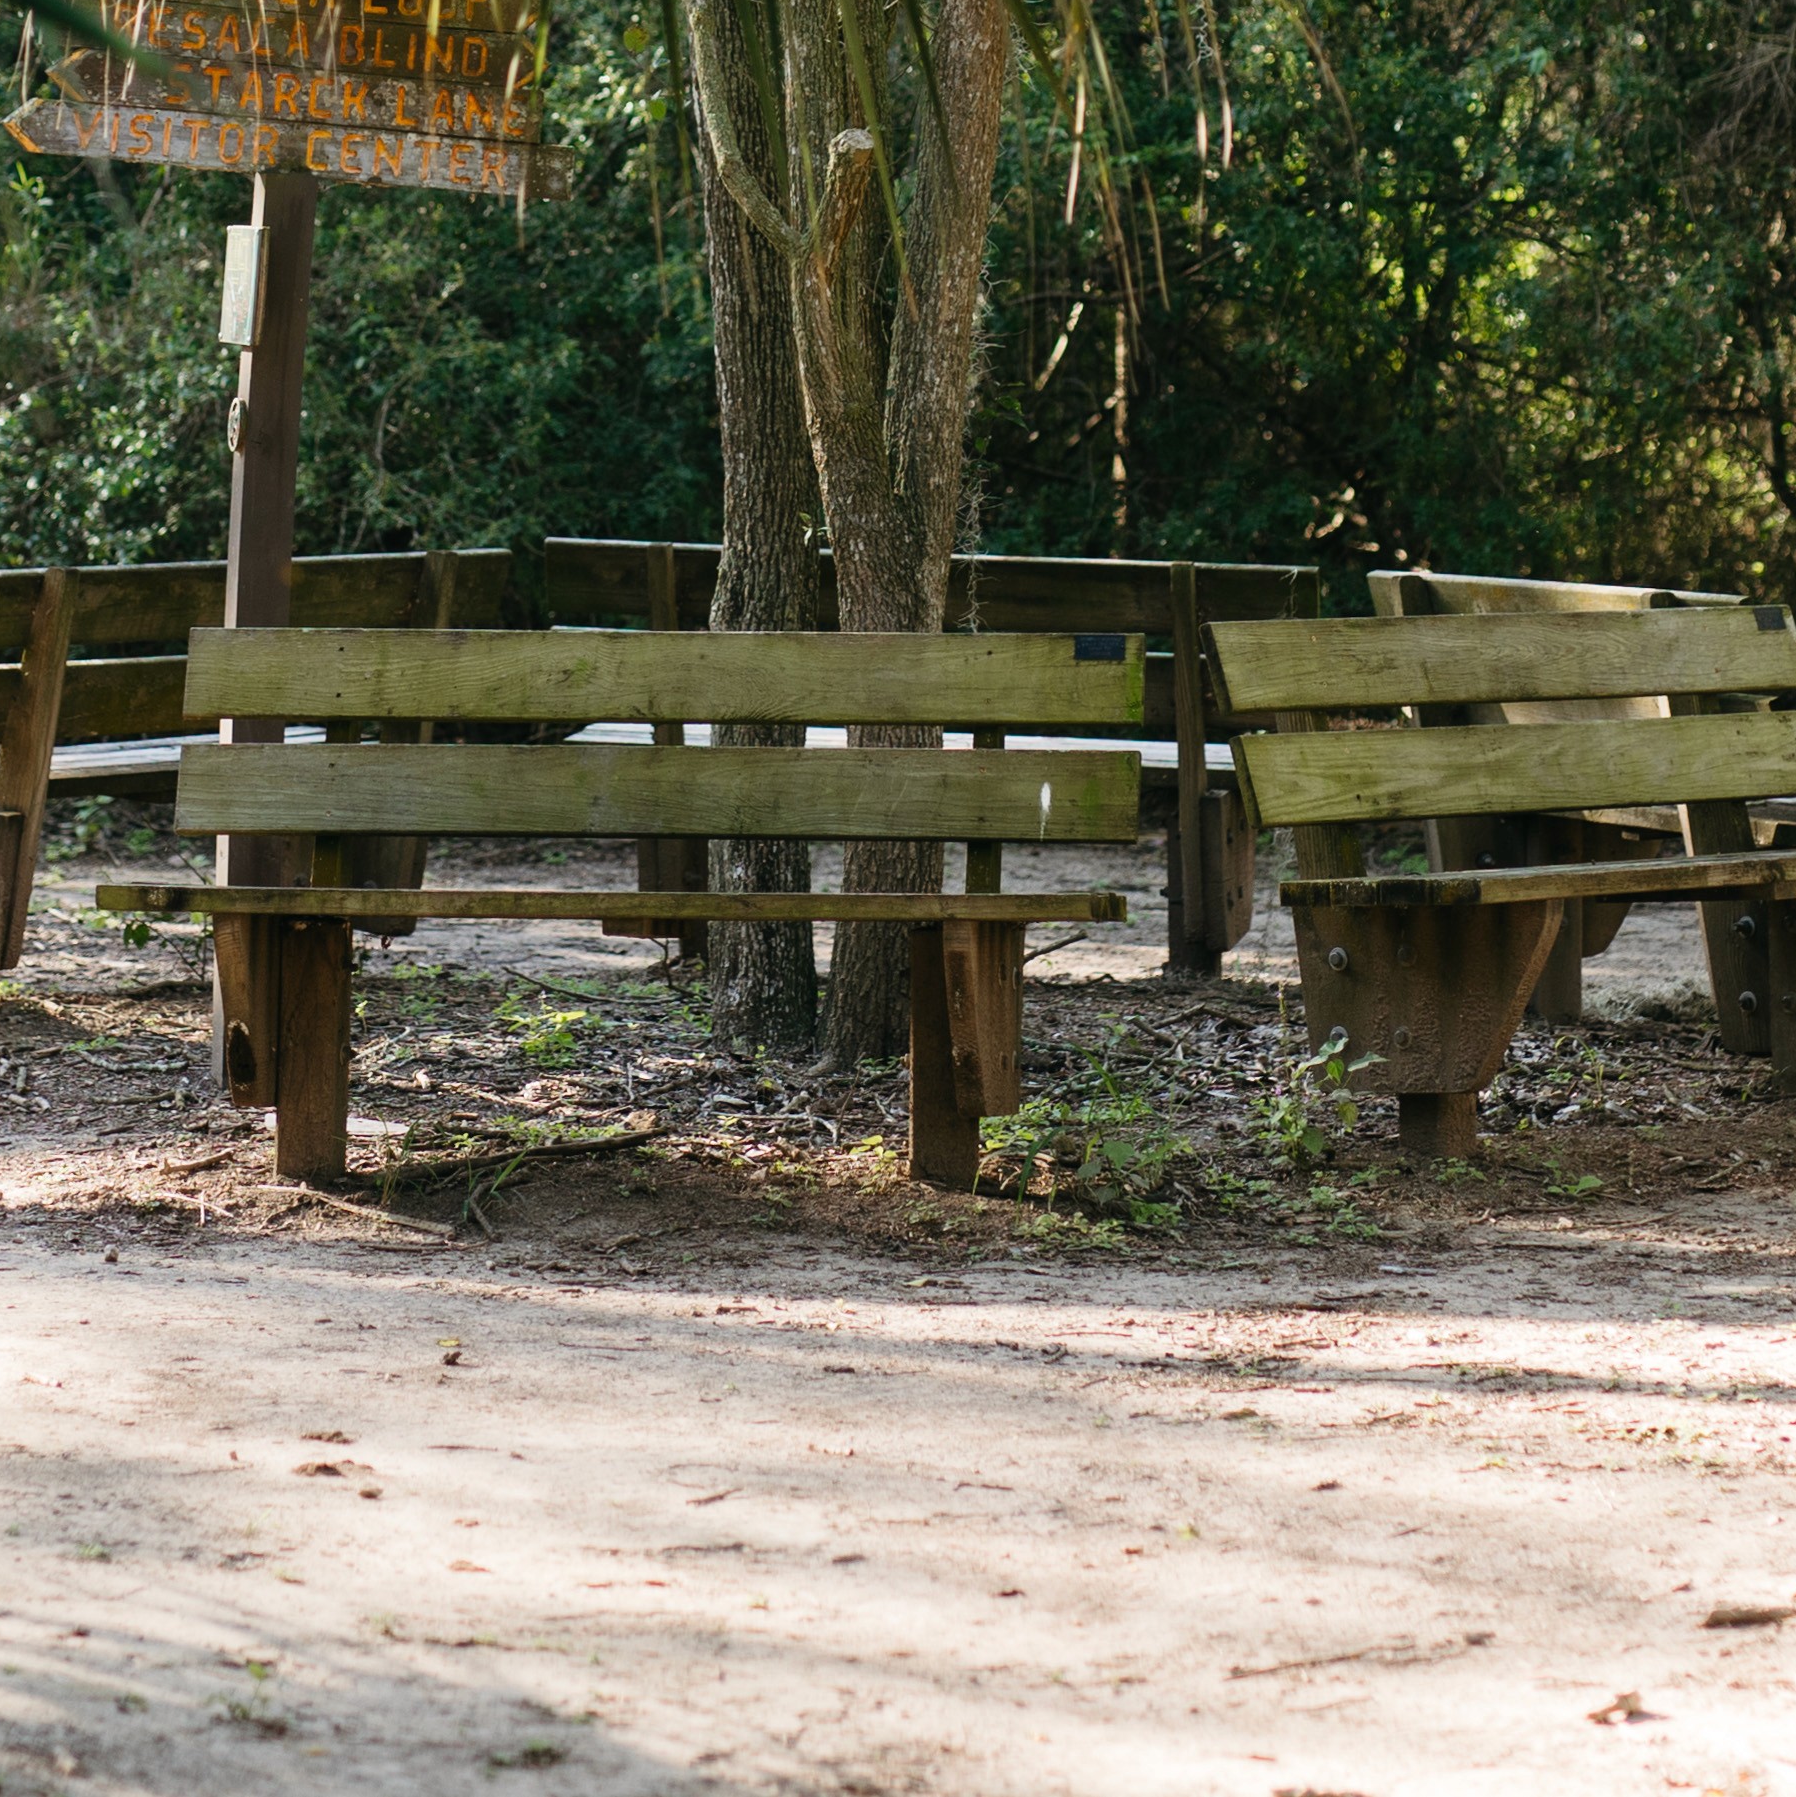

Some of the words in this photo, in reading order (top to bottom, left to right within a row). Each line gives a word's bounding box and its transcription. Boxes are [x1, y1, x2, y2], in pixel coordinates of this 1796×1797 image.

[114, 3, 310, 61] RESACA
[338, 24, 489, 78] BLIND
[166, 62, 368, 121] STARCK
[395, 84, 526, 137] LANE
[73, 111, 279, 167] VISITOR
[306, 130, 509, 188] CENTER
